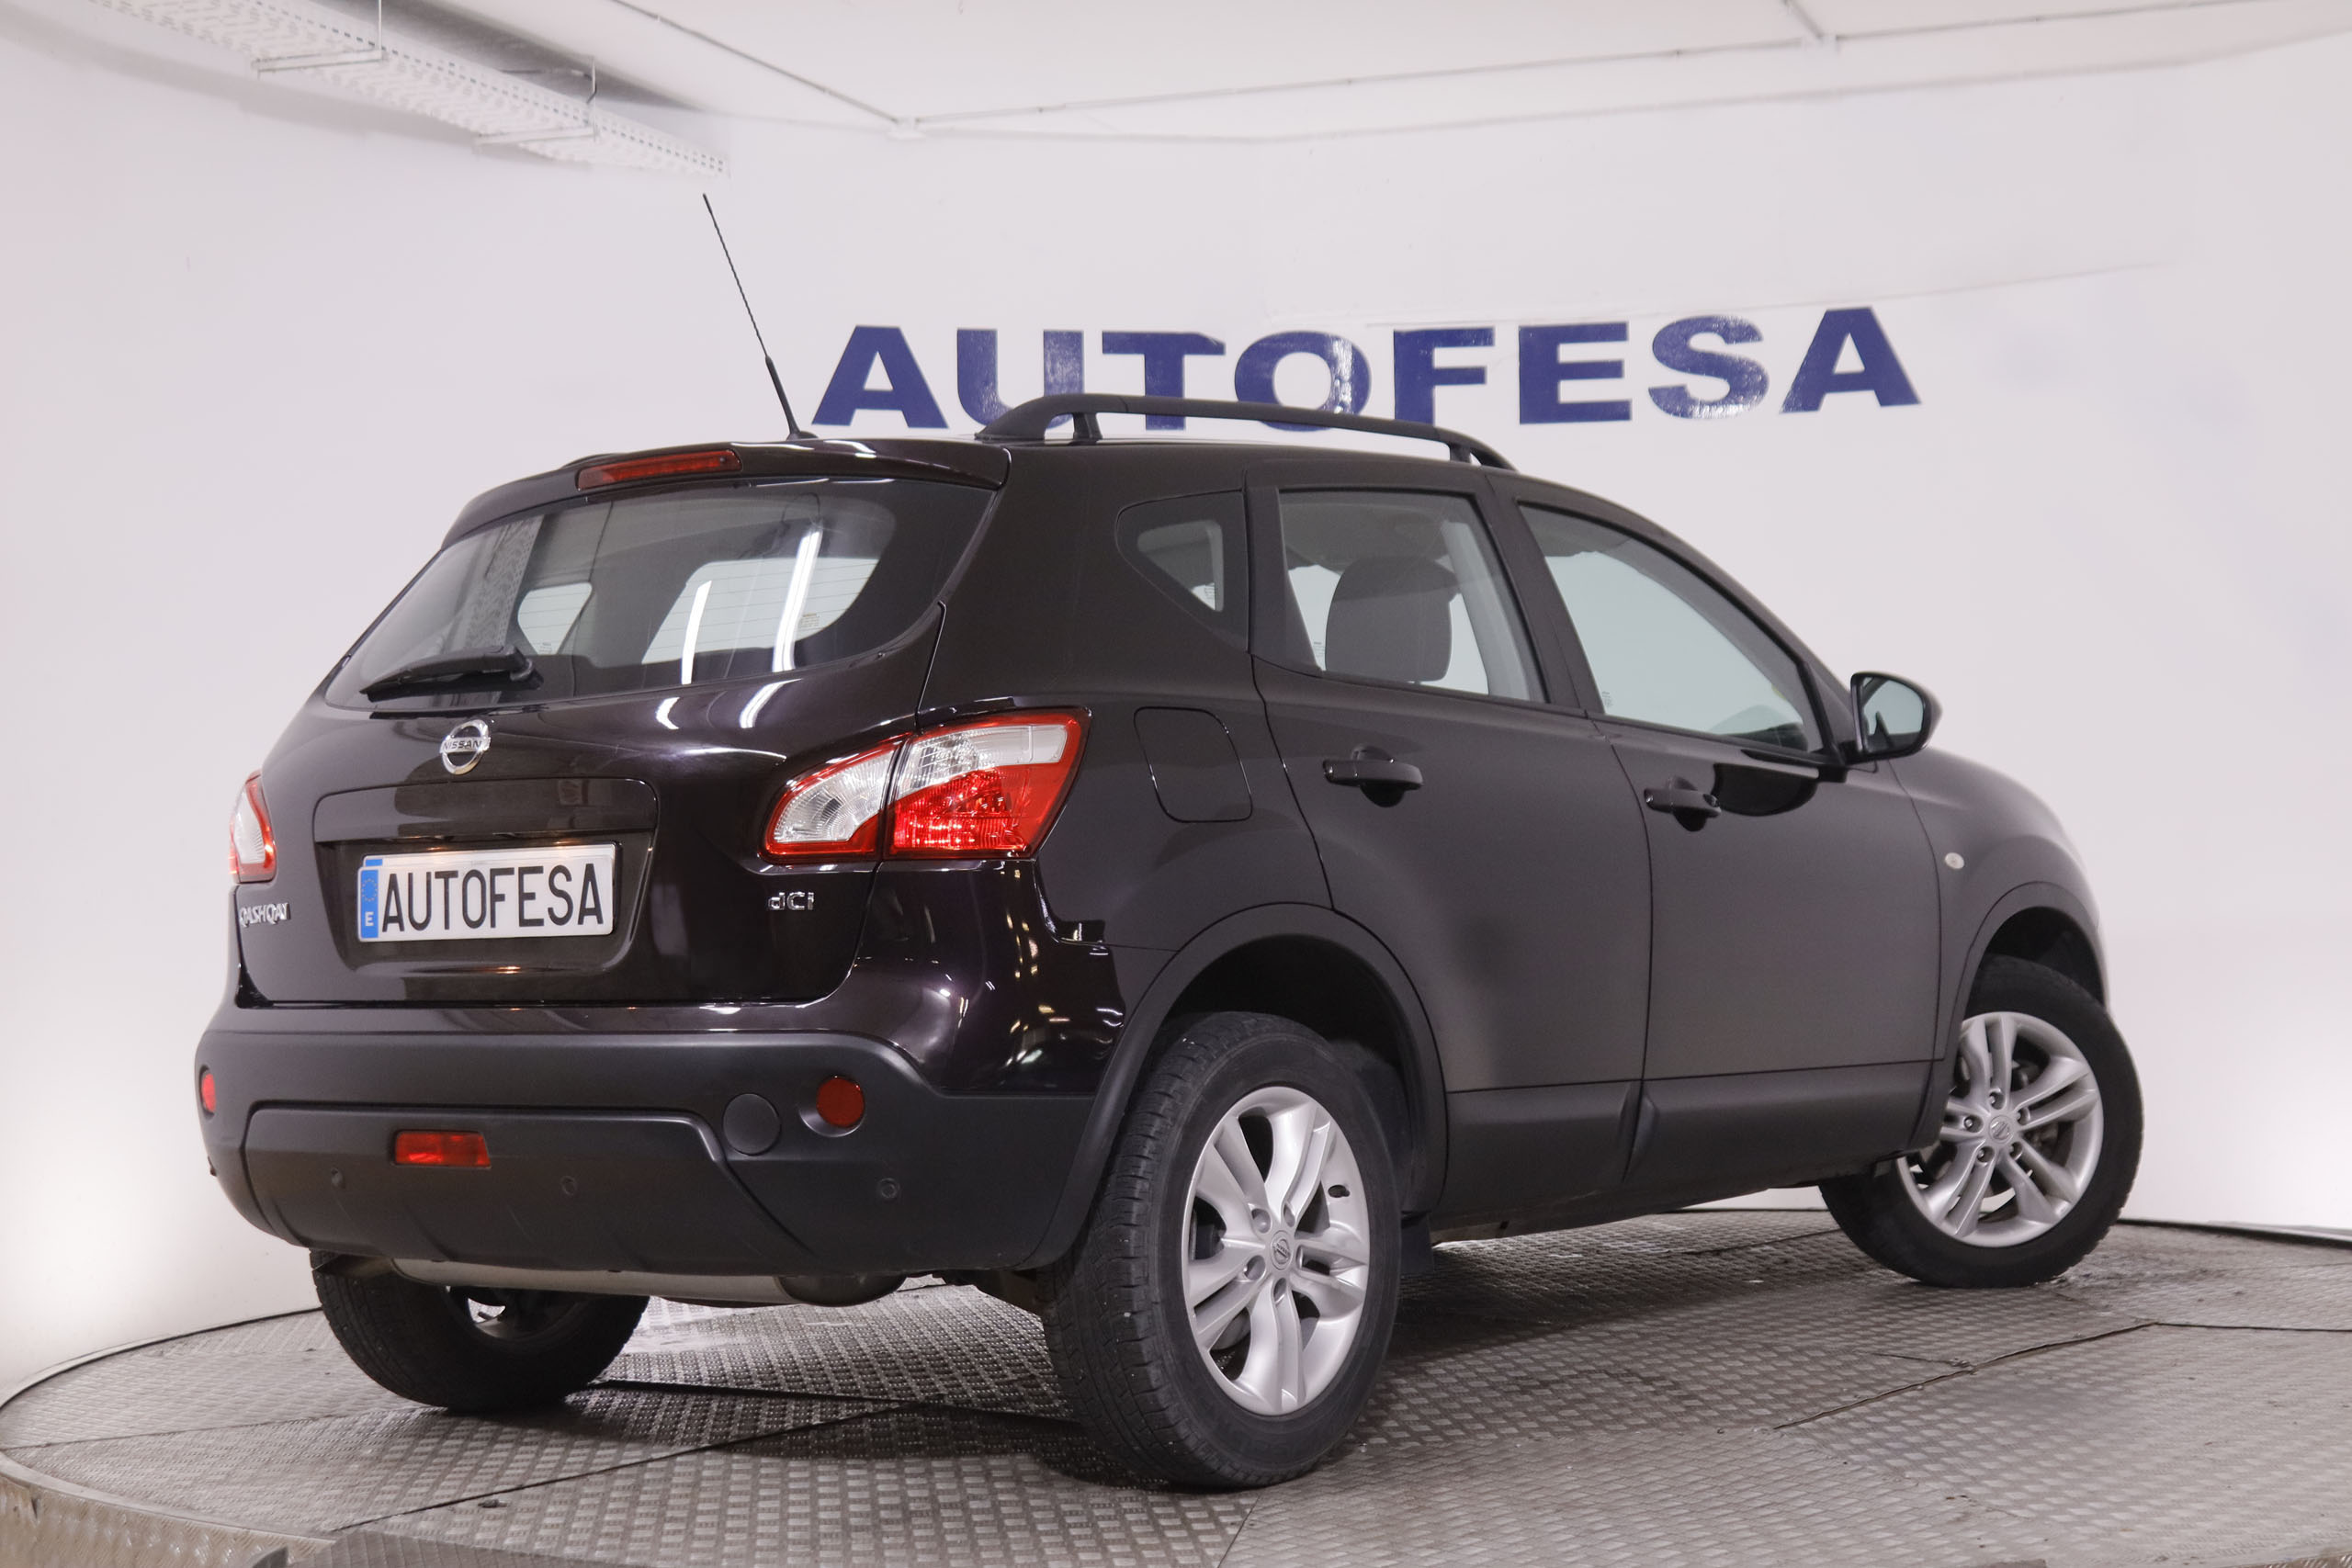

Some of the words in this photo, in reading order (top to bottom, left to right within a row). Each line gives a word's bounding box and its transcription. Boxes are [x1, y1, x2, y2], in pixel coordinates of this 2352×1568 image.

[810, 305, 1923, 433] AUTOFESA
[443, 739, 482, 750] NISSAN
[365, 911, 375, 927] E
[381, 863, 605, 933] AUTOFESA
